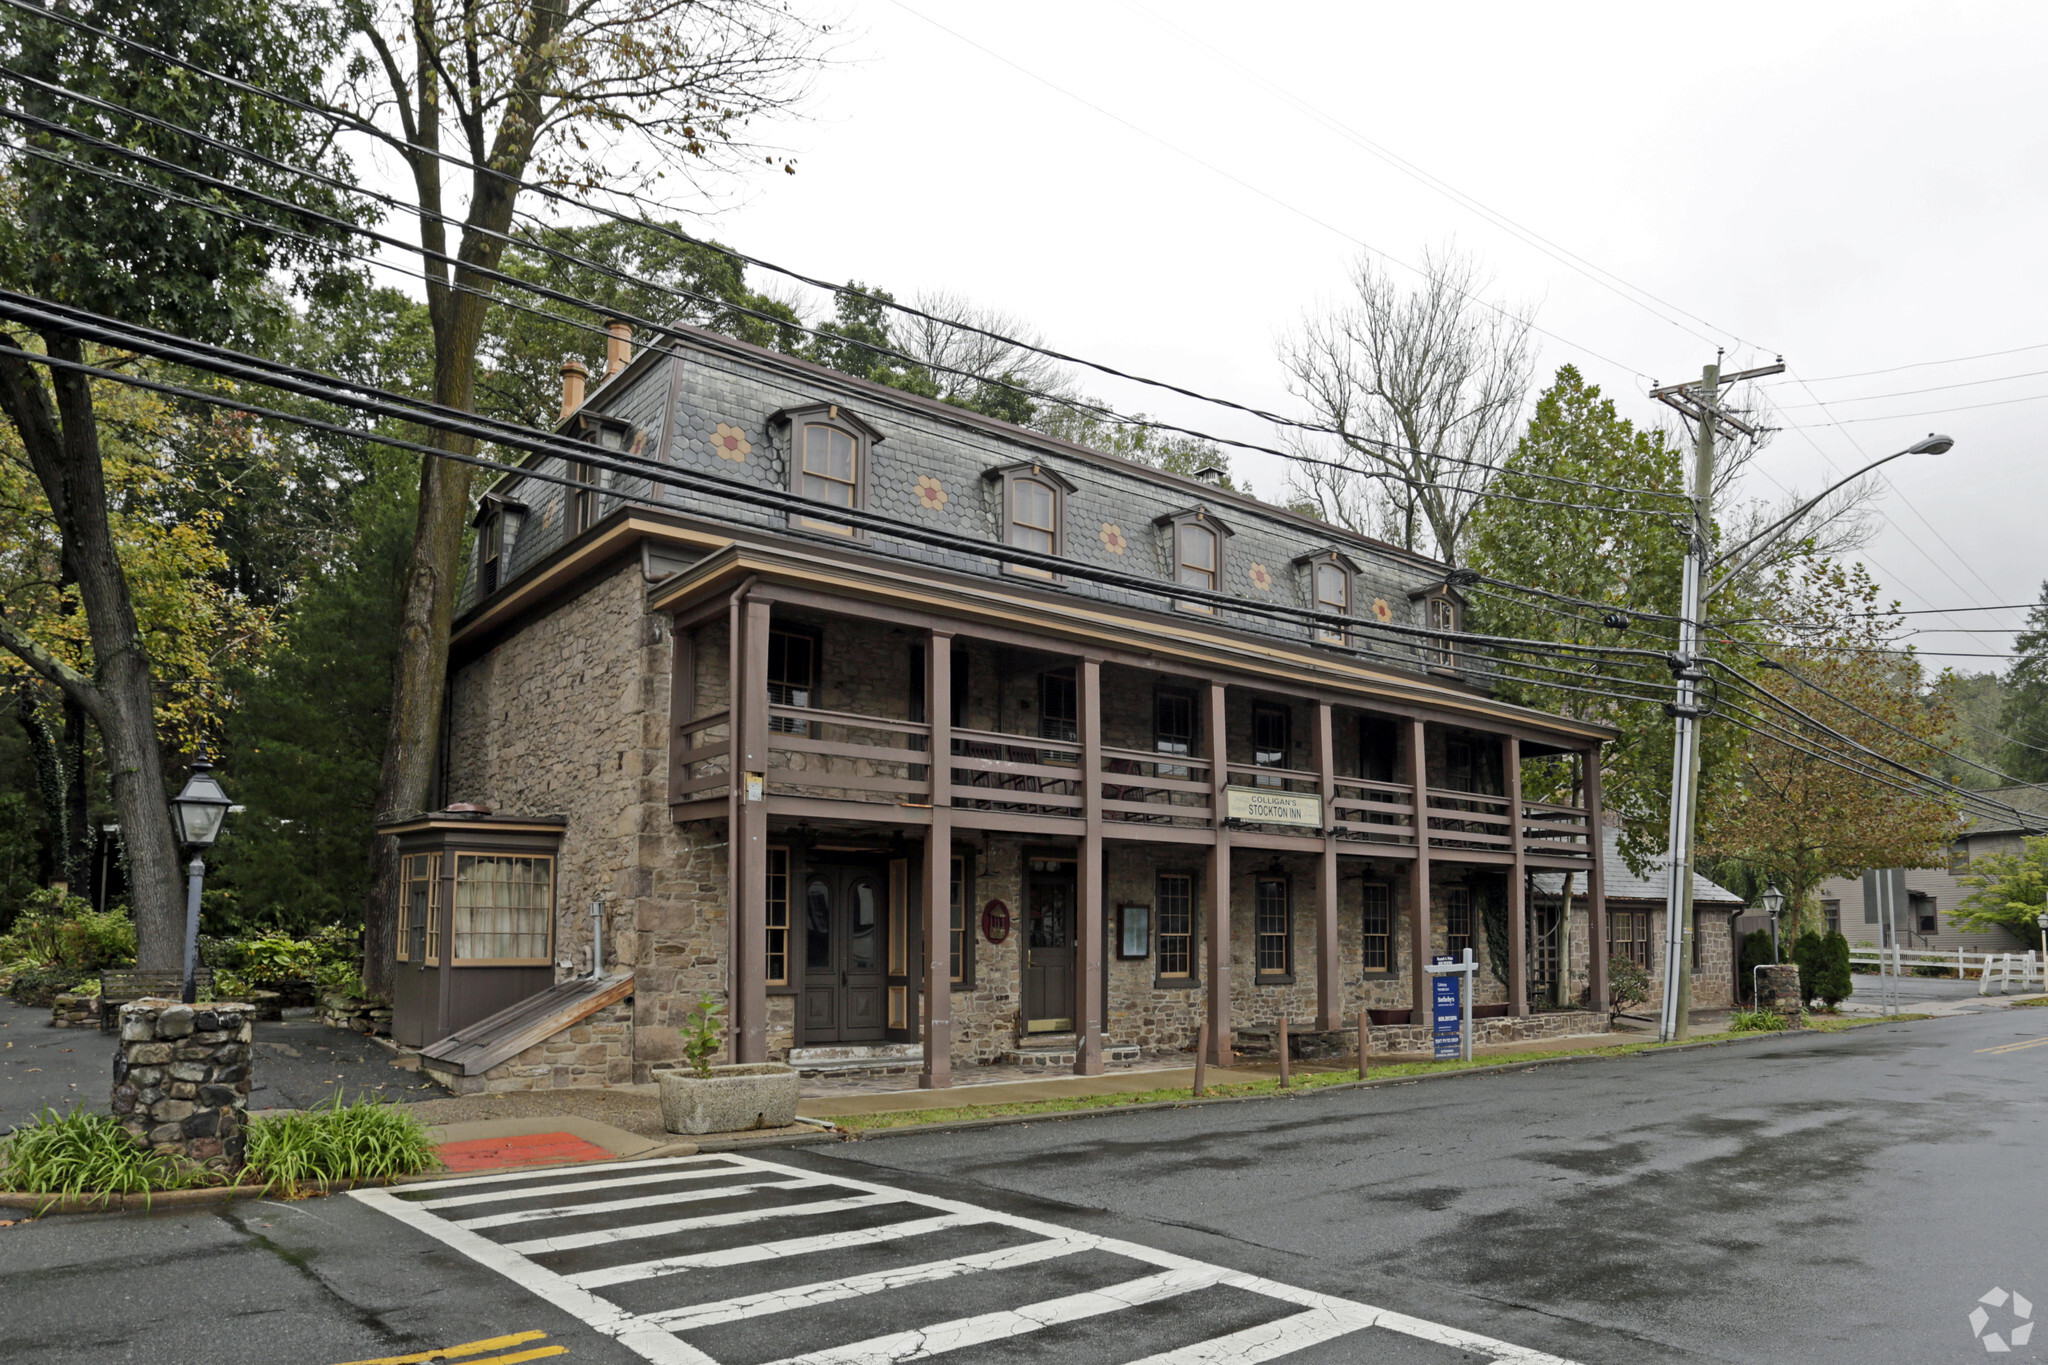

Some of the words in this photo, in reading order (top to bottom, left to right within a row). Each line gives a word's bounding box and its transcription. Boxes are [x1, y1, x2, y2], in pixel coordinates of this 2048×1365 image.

[1251, 796, 1297, 806] COLLIGAN'S
[1248, 804, 1288, 818] STOCKTON
[1289, 808, 1302, 819] INN
